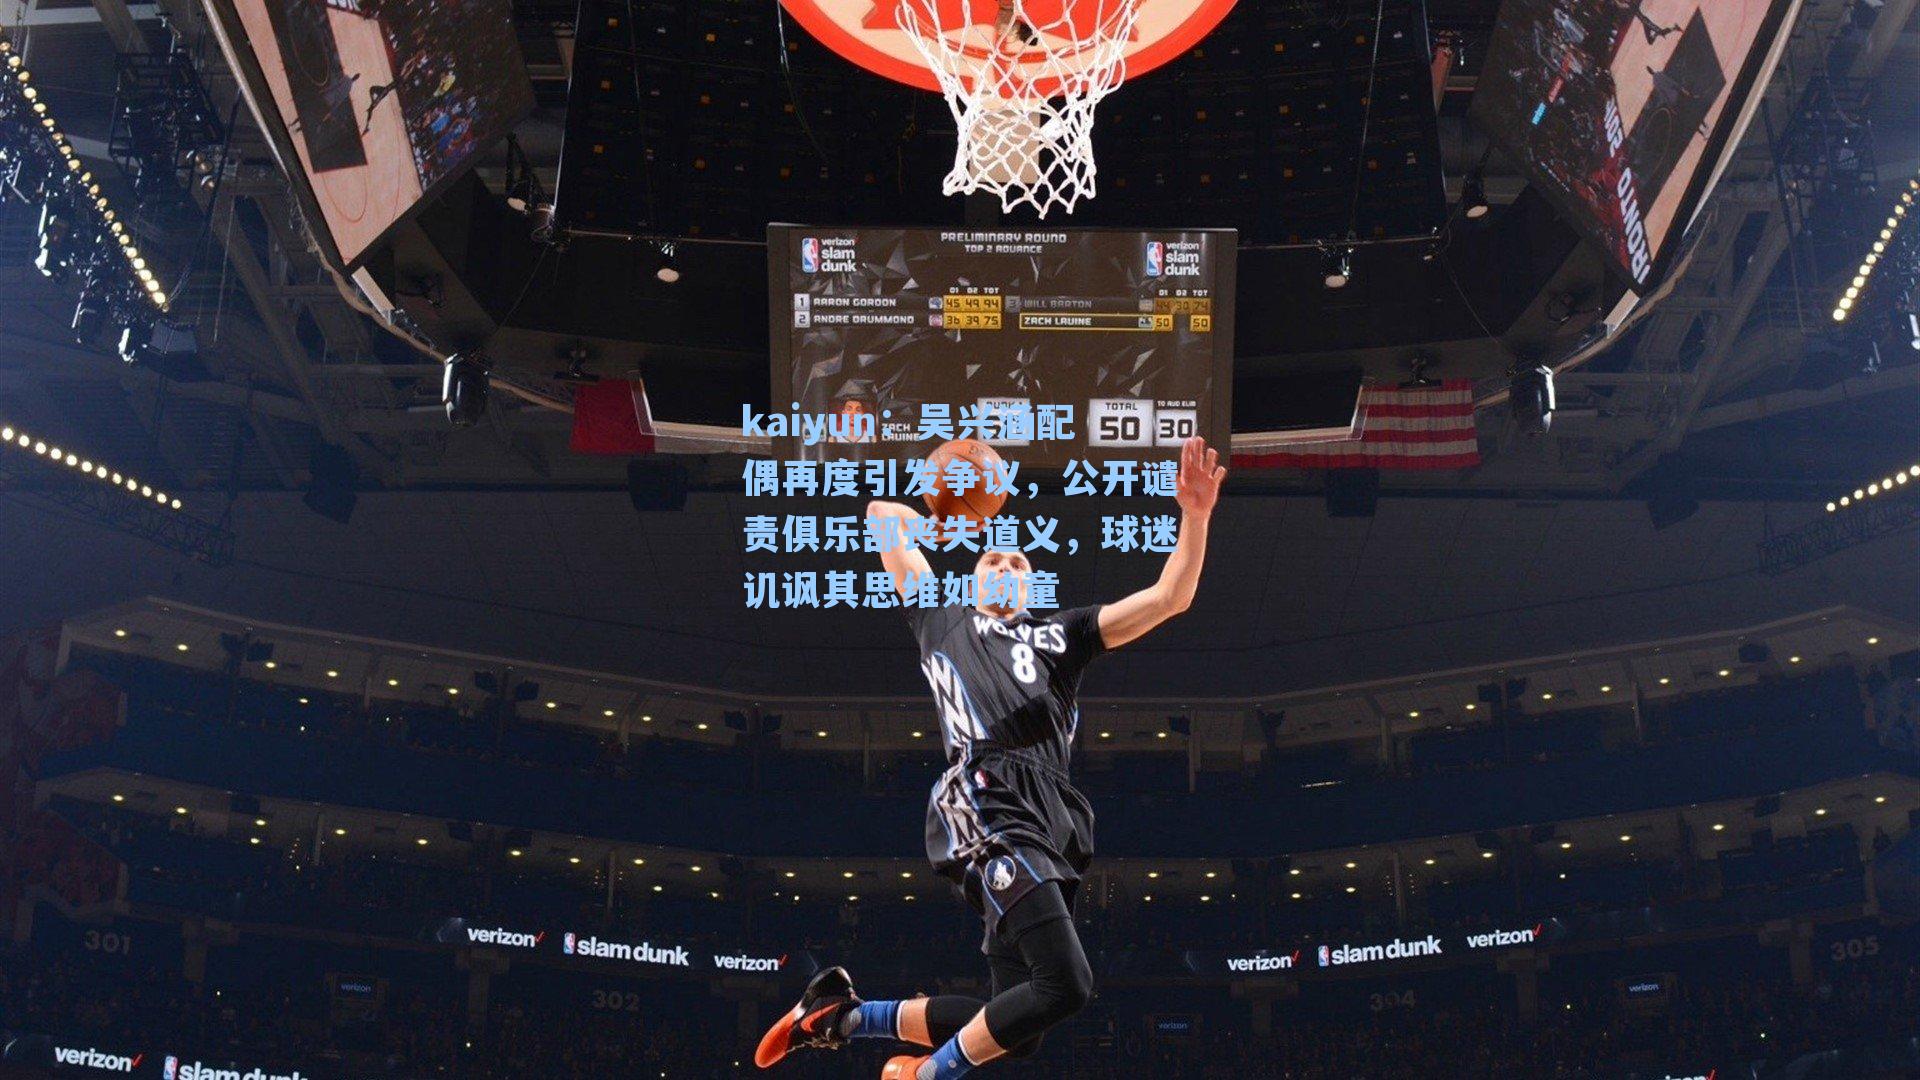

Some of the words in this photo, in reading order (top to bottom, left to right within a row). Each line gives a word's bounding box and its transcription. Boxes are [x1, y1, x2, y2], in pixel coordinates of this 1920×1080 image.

[821, 236, 855, 246] verizon
[940, 232, 1022, 243] PRELIMINARY
[1024, 233, 1067, 243] ROUND
[964, 244, 984, 254] TOP
[986, 244, 993, 254] 2
[1166, 241, 1200, 250] verizon
[821, 246, 856, 260] slam
[1166, 250, 1200, 263] slam
[821, 260, 857, 272] dunk
[1164, 263, 1200, 276] dunk
[814, 298, 848, 307] AARON
[852, 298, 896, 307] GORDON
[946, 298, 960, 308] 45
[965, 298, 979, 308] 49
[983, 298, 999, 308] 94
[1024, 300, 1048, 309] WILL
[1051, 300, 1093, 310] BARTON
[814, 315, 848, 324] ANDRE
[852, 315, 915, 324] DRUMMOND
[984, 315, 999, 325] 75
[1024, 316, 1050, 325] ZACH
[1156, 317, 1170, 328] 50
[1193, 317, 1208, 328] 50
[1100, 416, 1140, 440] 50
[1160, 419, 1192, 438] 30
[1011, 643, 1037, 684] 8
[85, 930, 132, 954] 301
[1831, 936, 1879, 960] 305
[468, 927, 535, 947] verizon
[714, 952, 778, 972] verizon
[1228, 954, 1292, 972] verizon
[1467, 928, 1534, 948] verizon
[592, 990, 640, 1012] 302
[54, 1046, 132, 1072] verizon
